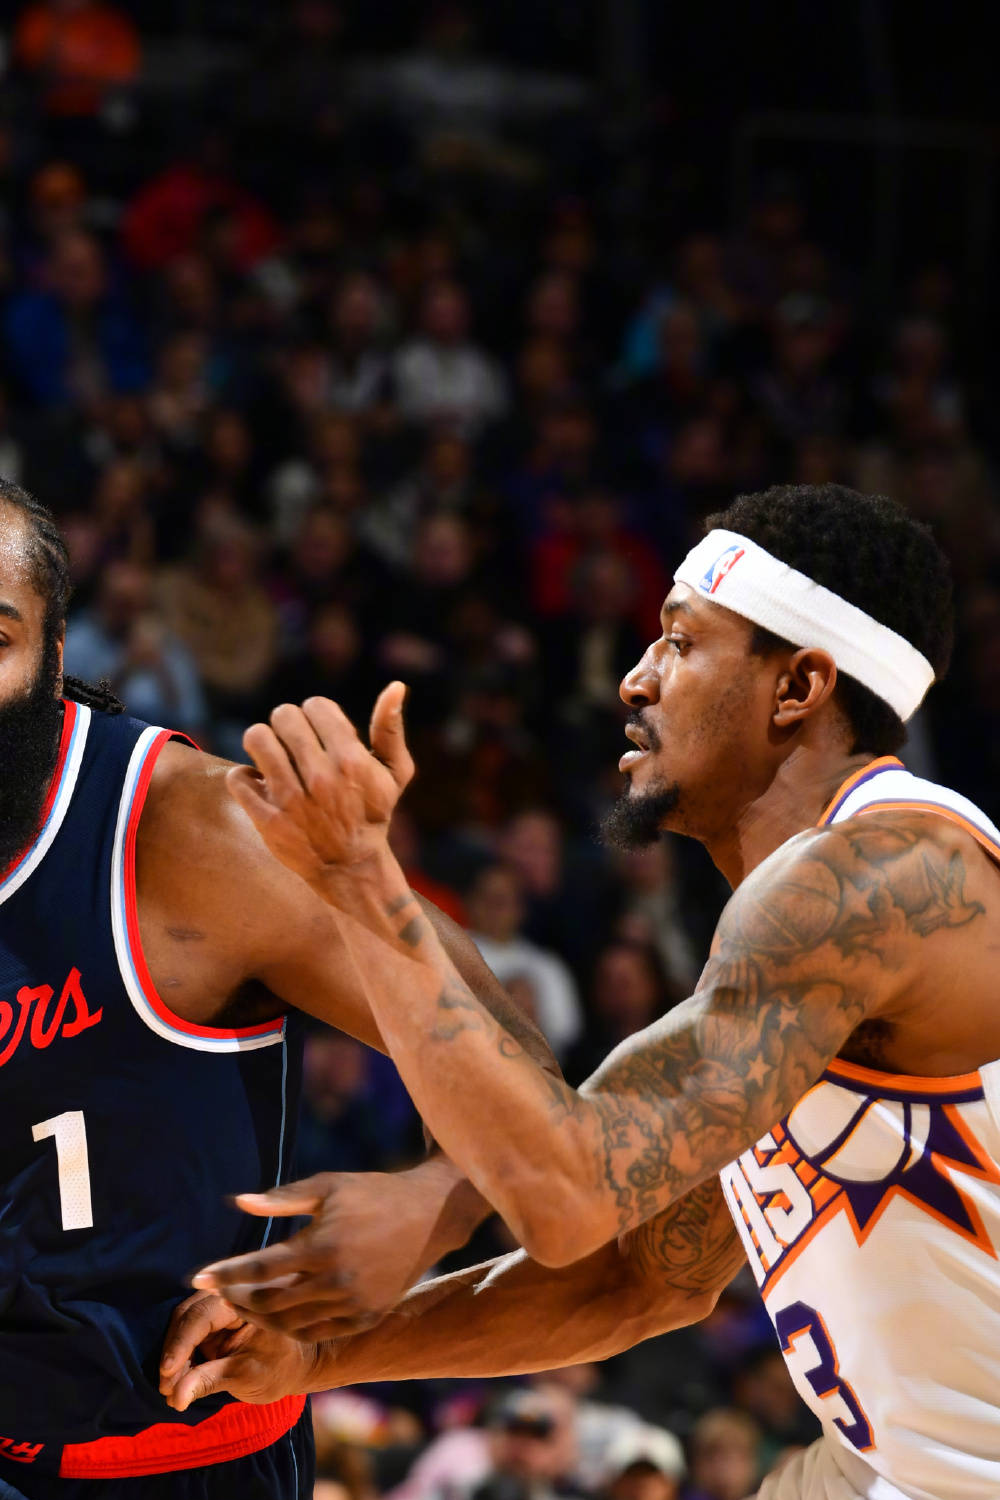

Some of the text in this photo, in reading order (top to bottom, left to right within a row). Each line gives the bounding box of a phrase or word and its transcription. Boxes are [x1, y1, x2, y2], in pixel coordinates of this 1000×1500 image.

[31, 1110, 94, 1231] 1
[720, 1132, 815, 1288] NS
[775, 1301, 877, 1452] 3
